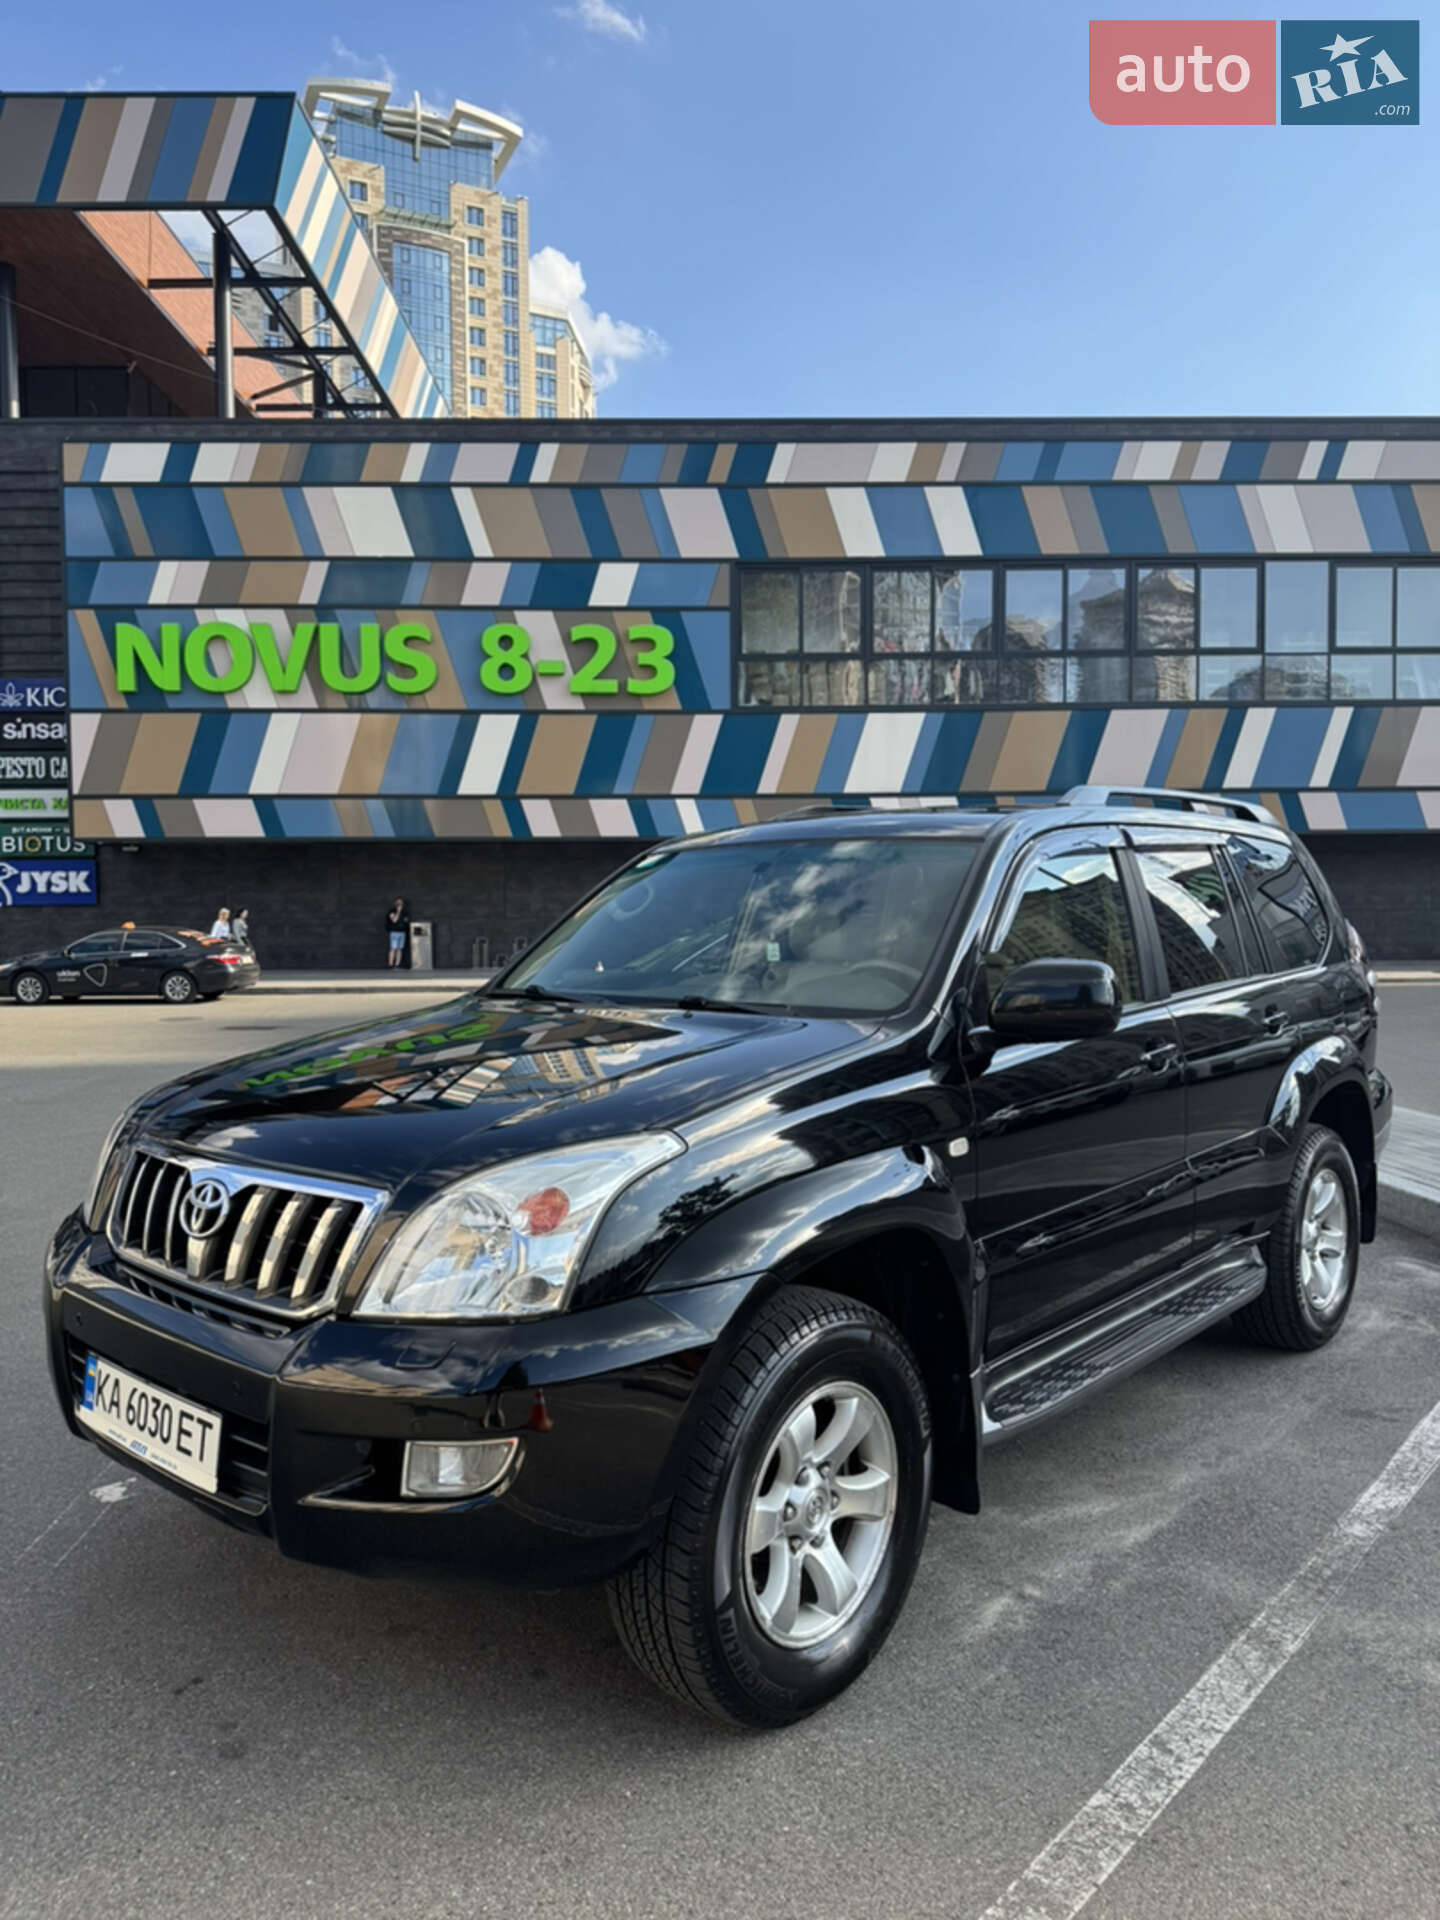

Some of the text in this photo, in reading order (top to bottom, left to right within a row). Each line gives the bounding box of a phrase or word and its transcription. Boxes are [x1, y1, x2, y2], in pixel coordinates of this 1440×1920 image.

[115, 621, 676, 695] NOVUS 8-23
[16, 870, 92, 894] JYSK
[95, 1368, 214, 1463] KA 6030 ET
